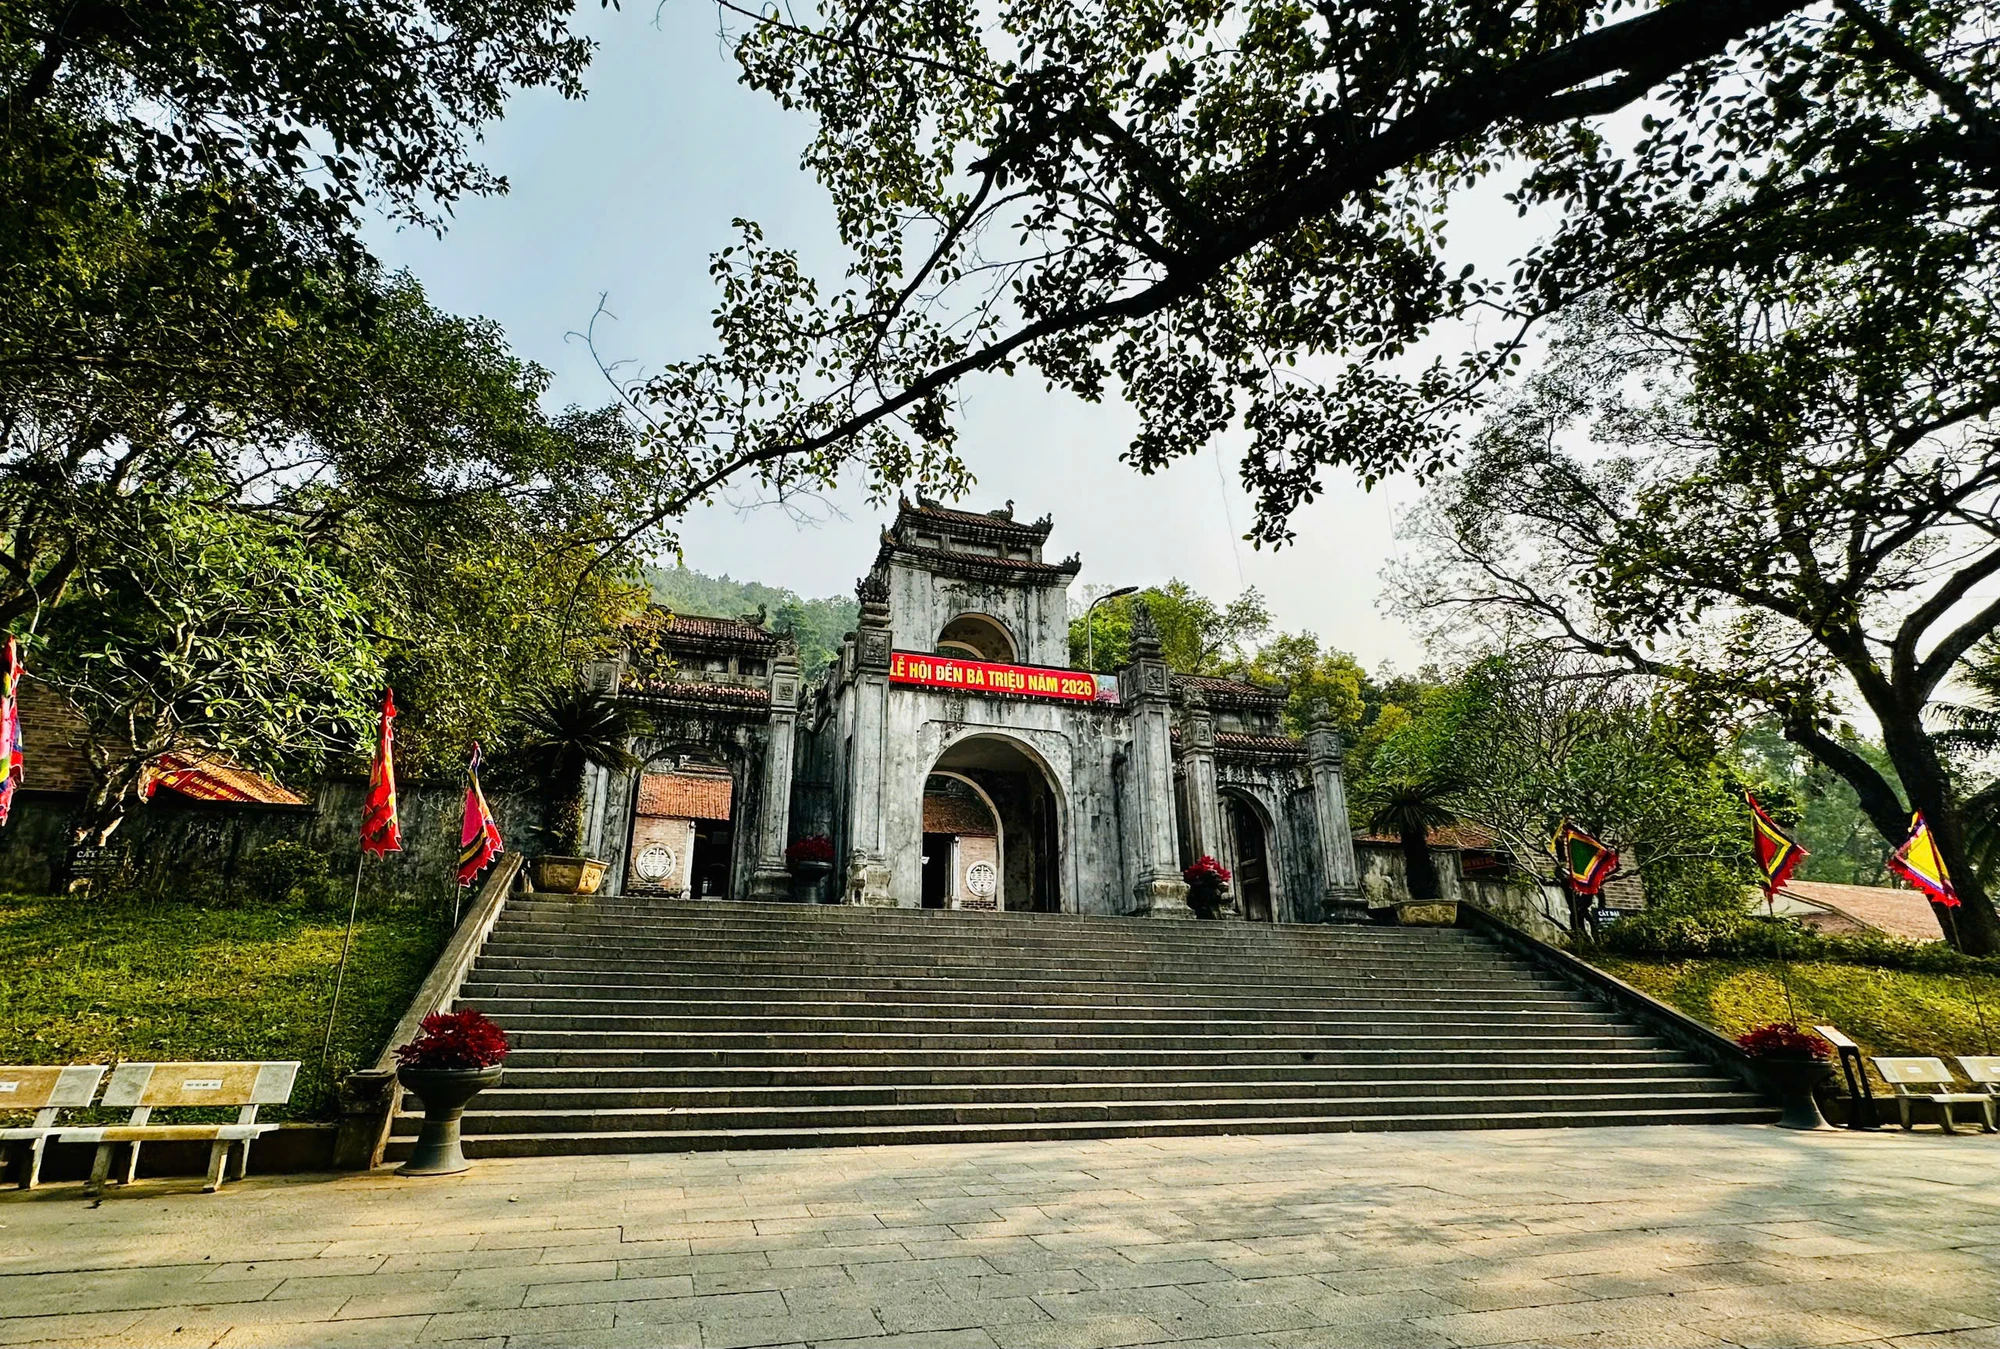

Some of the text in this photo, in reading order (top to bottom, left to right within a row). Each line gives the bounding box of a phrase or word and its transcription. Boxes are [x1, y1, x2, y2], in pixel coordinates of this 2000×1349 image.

[889, 656, 1093, 696] LỄ HỘI ĐỀN BÀ TRIỆU NĂM 2026
